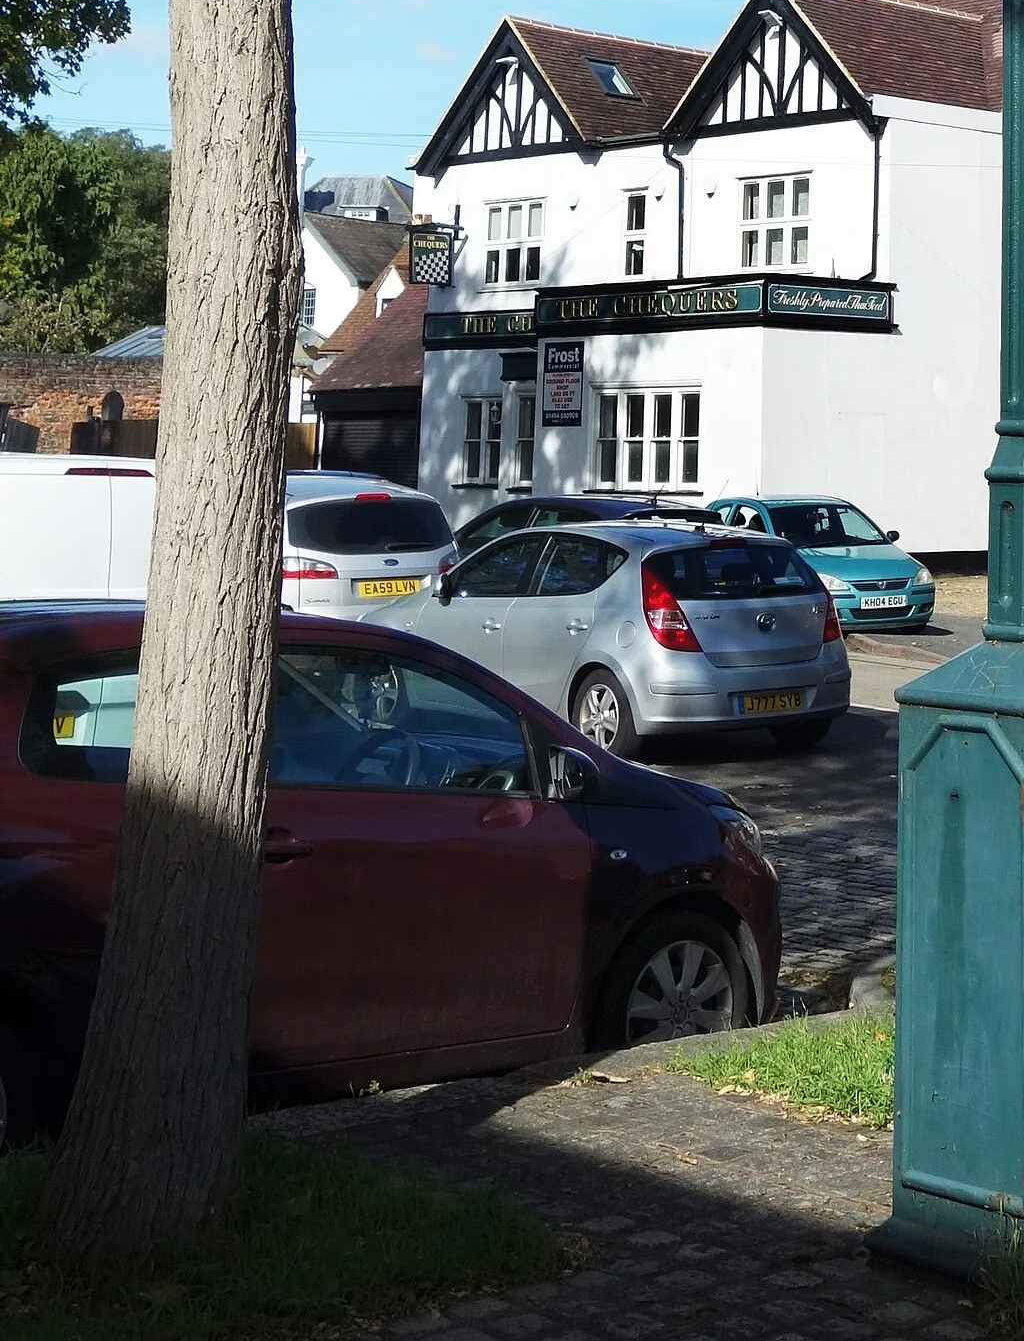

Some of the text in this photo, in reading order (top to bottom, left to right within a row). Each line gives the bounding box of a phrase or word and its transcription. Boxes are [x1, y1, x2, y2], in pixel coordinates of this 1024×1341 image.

[413, 240, 449, 250] CHEQUERS
[555, 288, 739, 320] THE CHEQUERS
[773, 289, 809, 310] Freshly
[807, 291, 851, 310] Prepared
[461, 316, 496, 335] THE
[548, 347, 580, 363] Frost
[364, 581, 416, 595] EA59 LVN
[864, 596, 904, 607] KH04 EGU
[747, 692, 802, 711] J777 SYB
